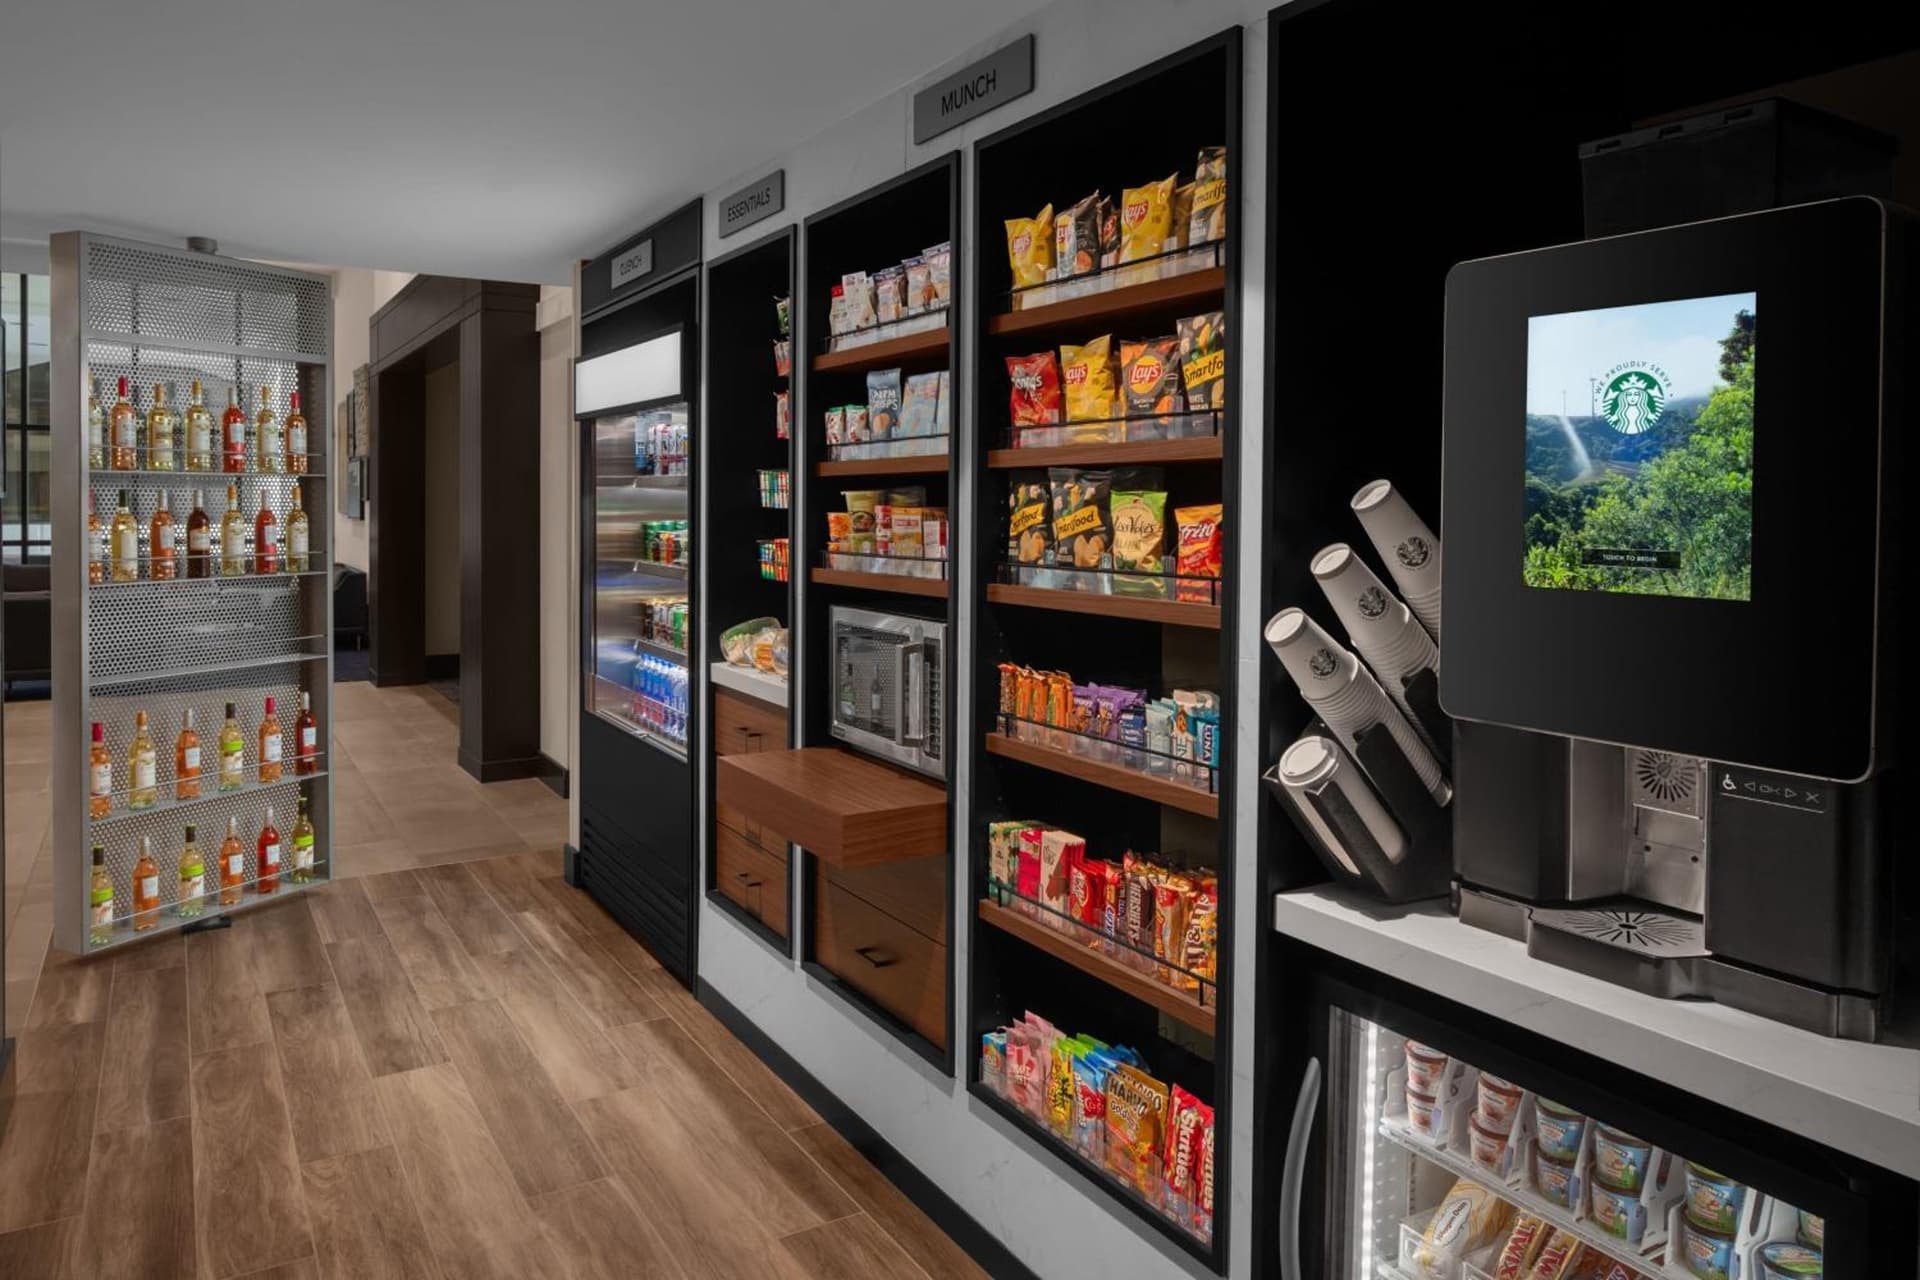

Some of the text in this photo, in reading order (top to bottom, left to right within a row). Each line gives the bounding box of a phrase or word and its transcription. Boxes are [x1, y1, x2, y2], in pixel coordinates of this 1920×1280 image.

[941, 68, 997, 117] MUNCH
[727, 186, 772, 223] ESSENTIALS
[1605, 360, 1648, 380] PROUDLY
[1650, 363, 1673, 389] SERVE
[1602, 553, 1625, 561] TOUCH
[1636, 555, 1658, 563] BEGIN
[1203, 723, 1213, 759] LUNA
[1175, 1108, 1196, 1187] Skittles
[1500, 1225, 1536, 1278] TWIX
